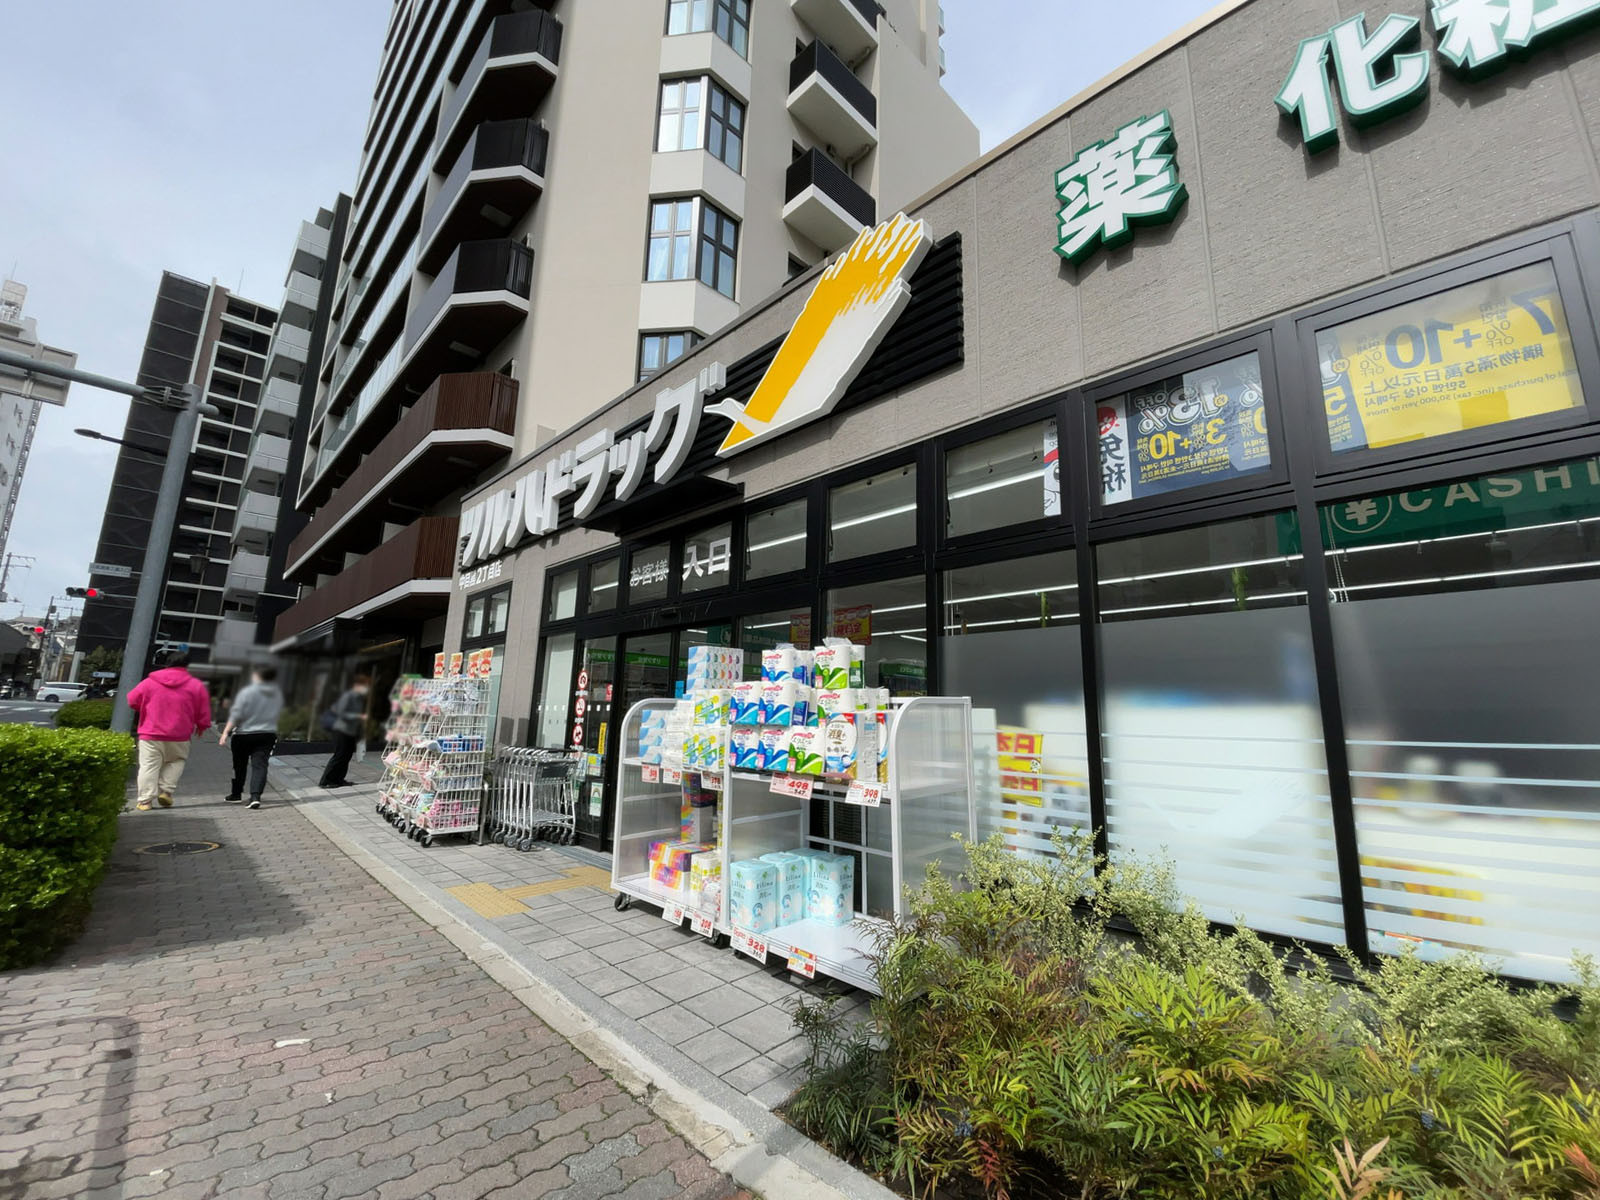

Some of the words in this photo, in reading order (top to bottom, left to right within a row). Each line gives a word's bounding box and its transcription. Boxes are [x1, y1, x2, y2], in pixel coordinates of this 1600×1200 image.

[1053, 108, 1186, 263] 薬
[461, 361, 727, 568] ツルハドラッグ
[1399, 456, 1600, 513] CASHI
[629, 559, 670, 587] お客様
[682, 536, 731, 581] 入口
[788, 780, 809, 790] 498
[863, 788, 879, 799] 398
[747, 938, 766, 954] 328
